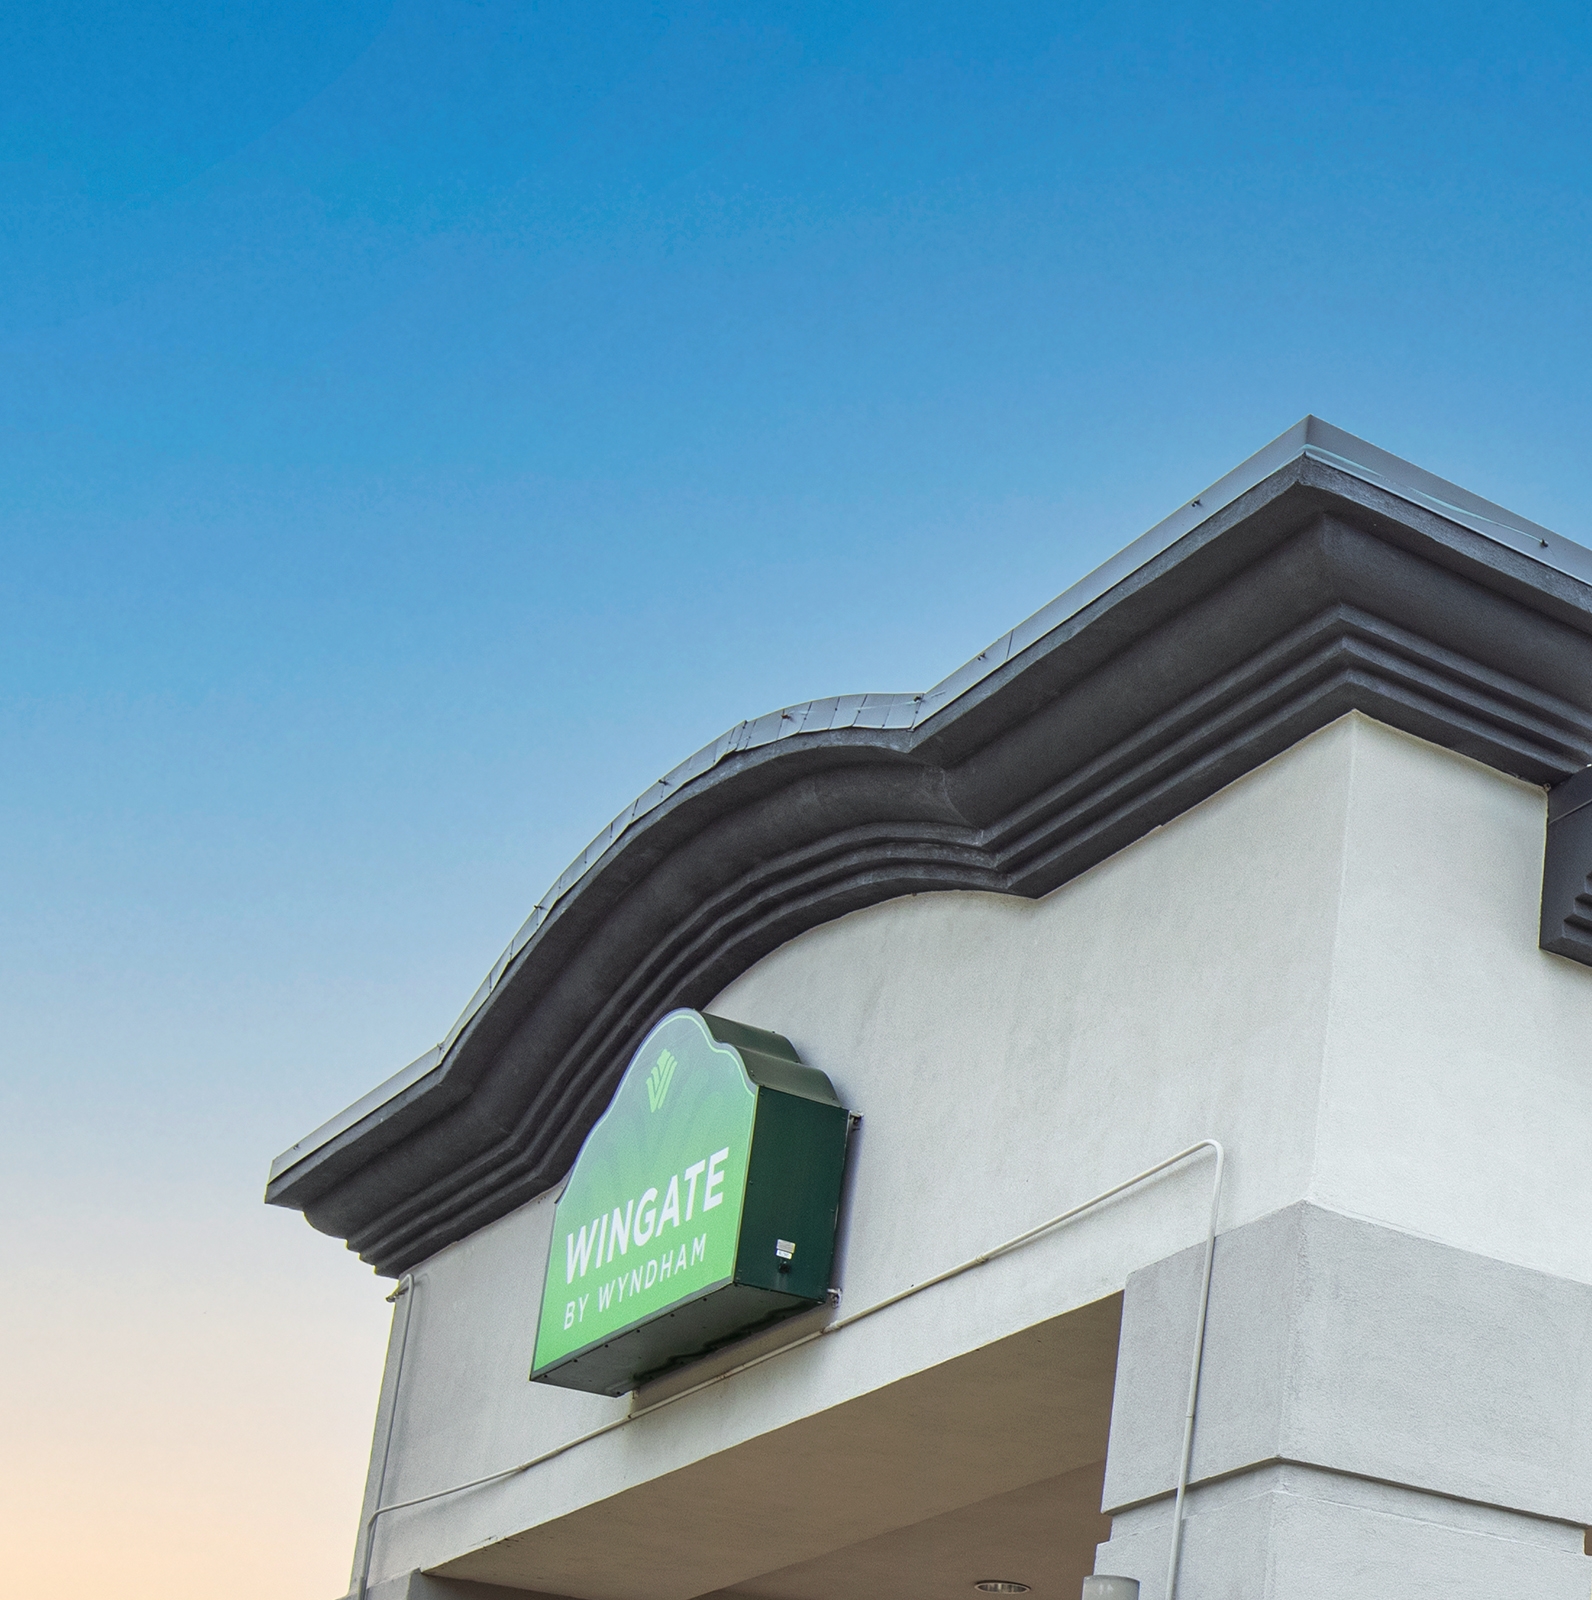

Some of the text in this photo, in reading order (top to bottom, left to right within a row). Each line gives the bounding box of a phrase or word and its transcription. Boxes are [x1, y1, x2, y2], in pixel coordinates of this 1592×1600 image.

[565, 1146, 730, 1285] WINGATE
[563, 1232, 708, 1330] BY WYNDHAM
